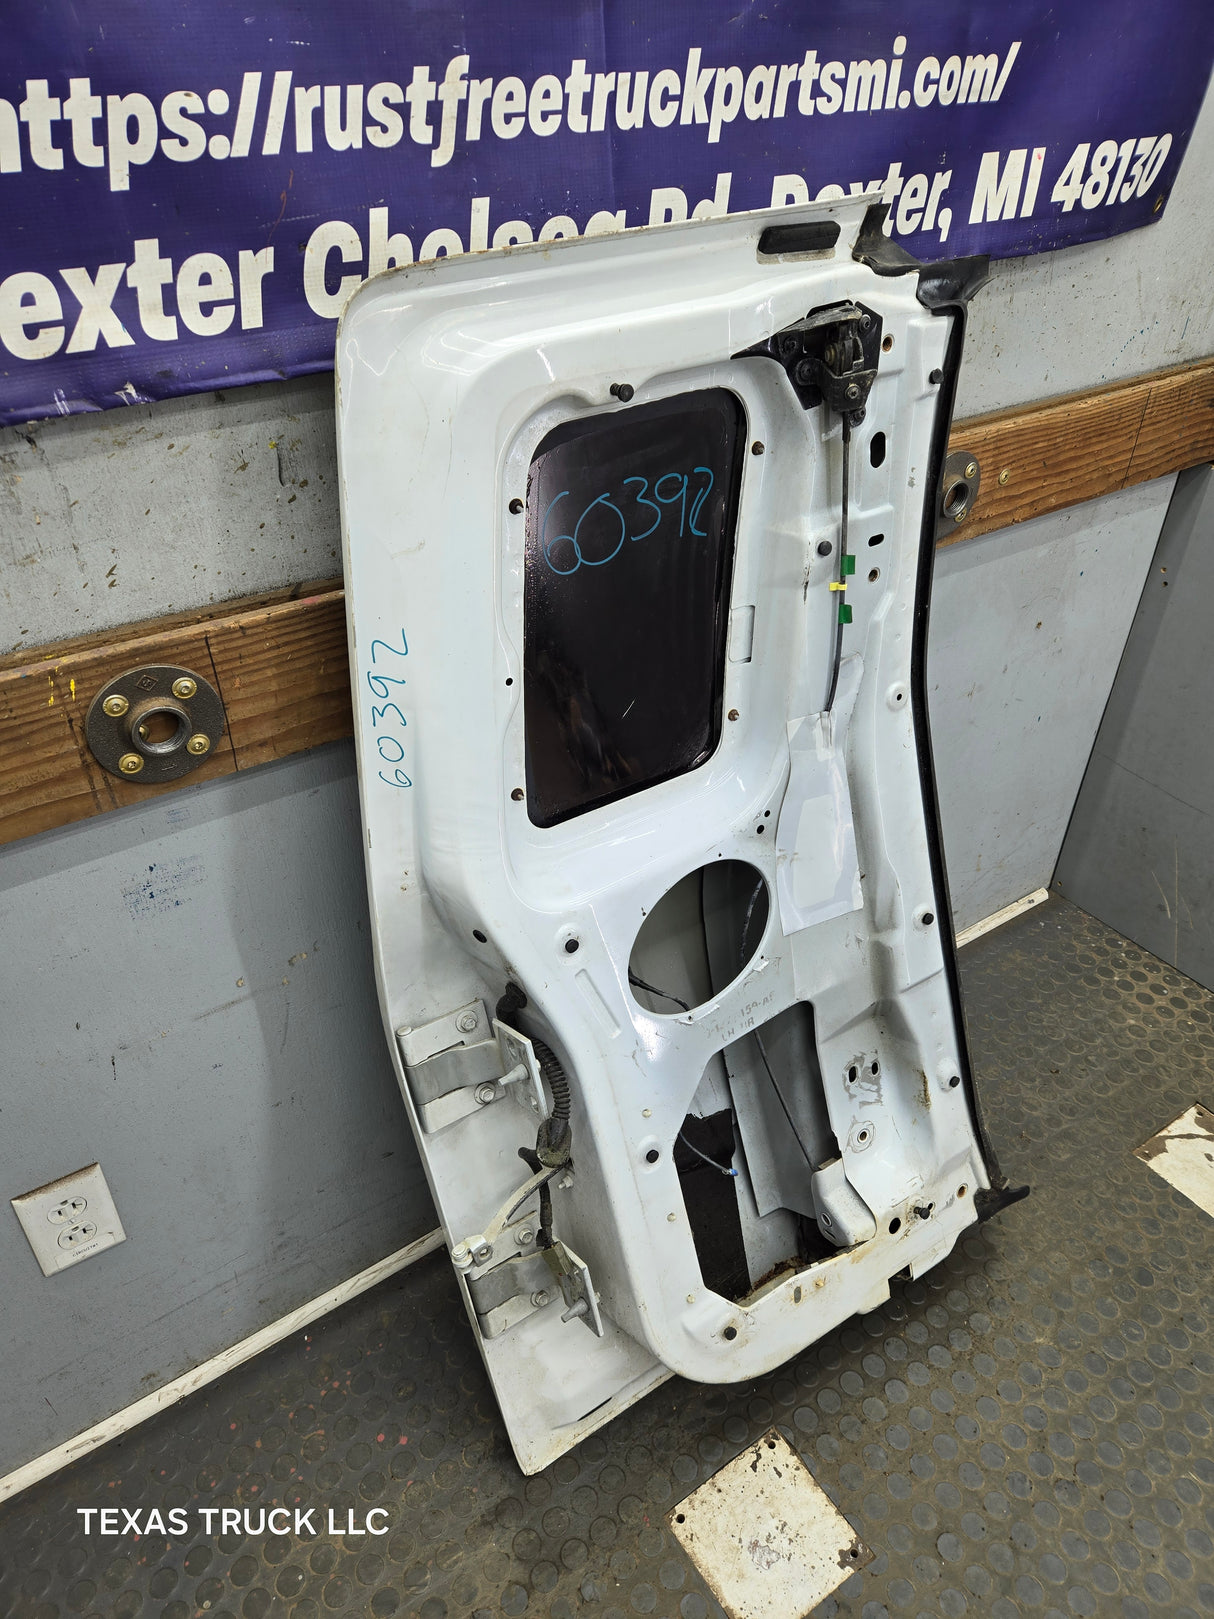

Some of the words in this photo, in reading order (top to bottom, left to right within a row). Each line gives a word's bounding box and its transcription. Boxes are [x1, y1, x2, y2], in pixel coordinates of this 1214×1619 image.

[968, 146, 1046, 225] MI
[1050, 132, 1173, 213] 48130
[542, 466, 714, 575] 60392
[367, 627, 413, 788] 60392
